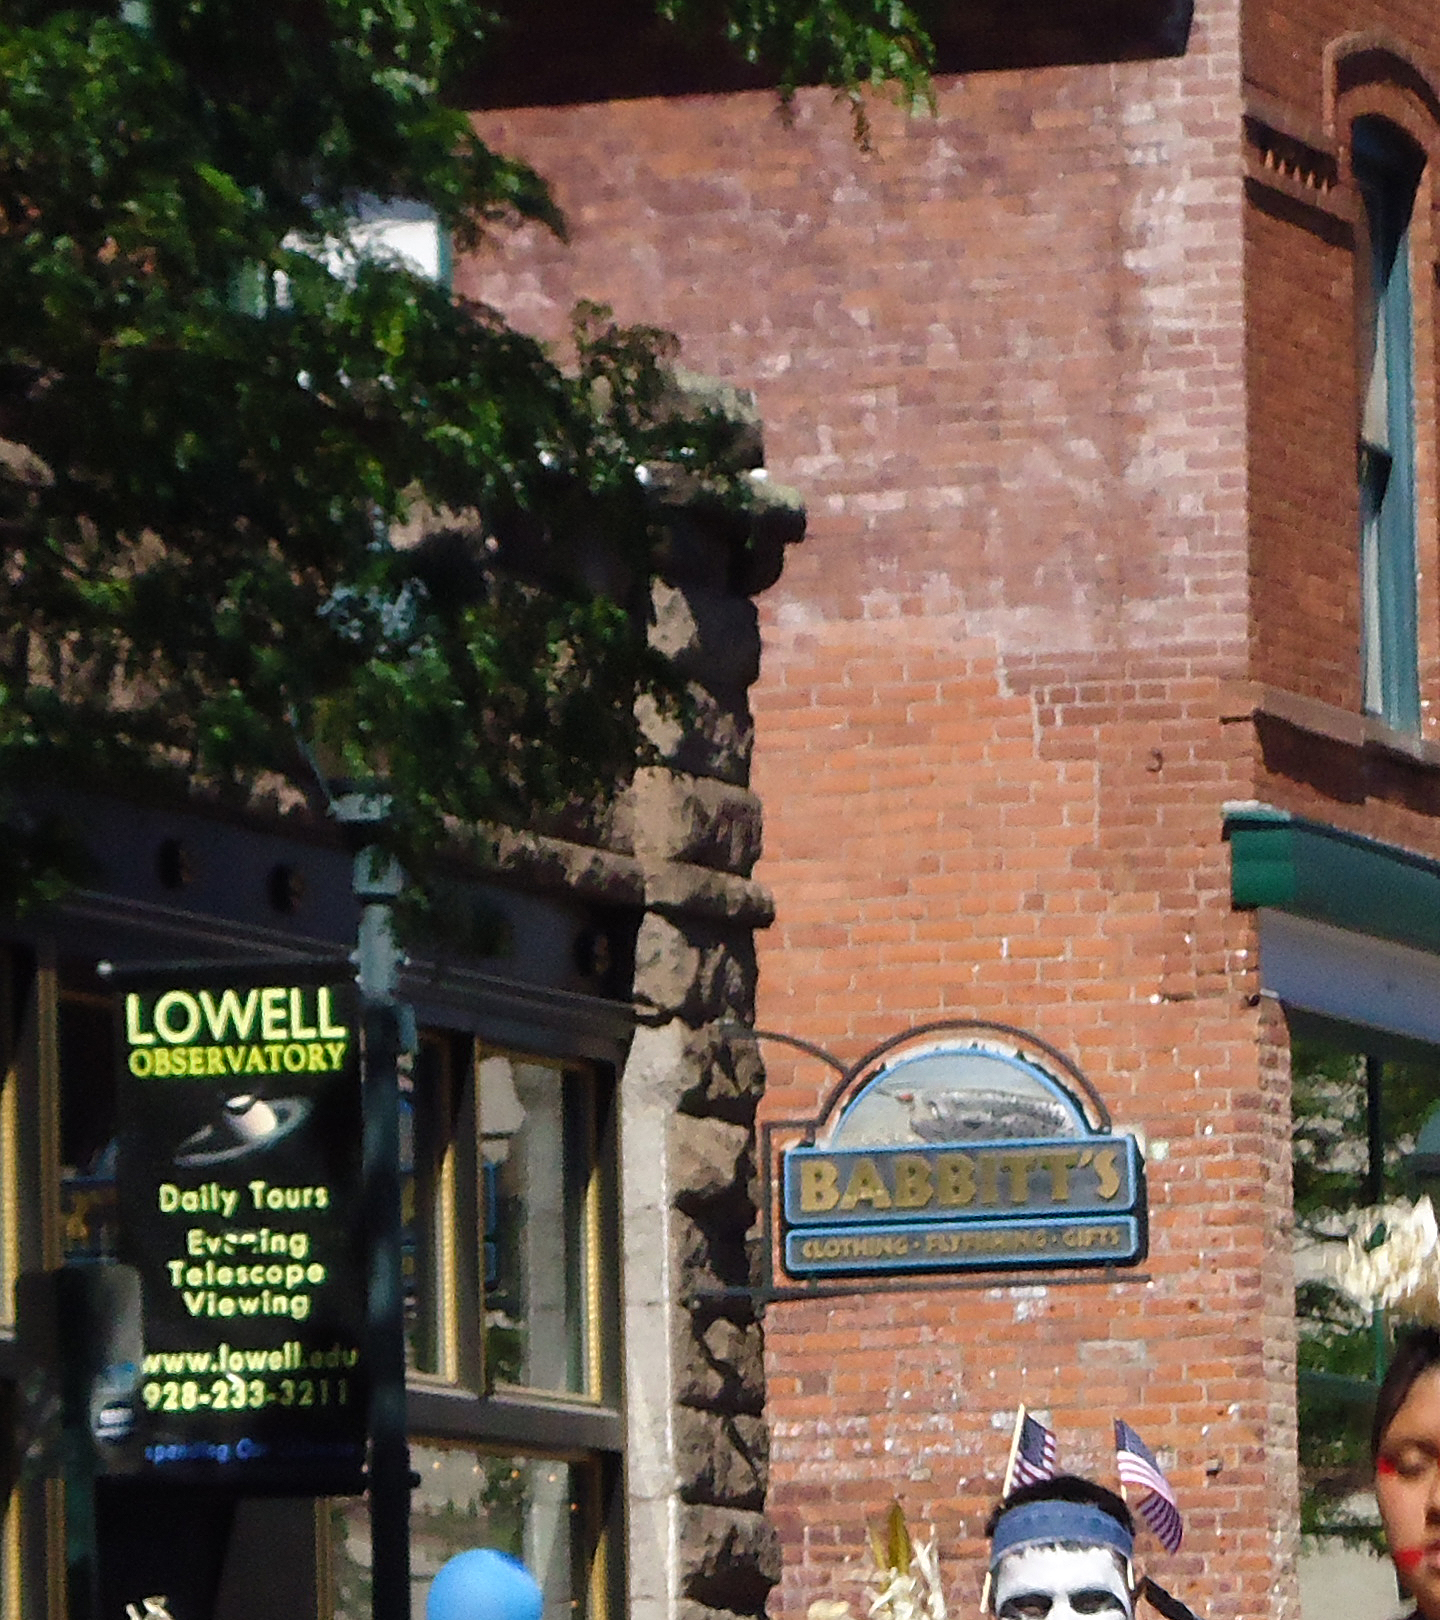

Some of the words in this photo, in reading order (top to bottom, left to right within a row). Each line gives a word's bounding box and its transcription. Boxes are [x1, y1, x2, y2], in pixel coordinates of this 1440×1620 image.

[125, 986, 347, 1045] LOWELL
[128, 1042, 346, 1078] OBSERVATORY
[159, 1183, 240, 1217] Daily
[249, 1180, 330, 1211] Tours
[799, 1149, 1122, 1213] BABBITT'S
[167, 1259, 327, 1290] Telescope
[183, 1290, 311, 1321] Viewing
